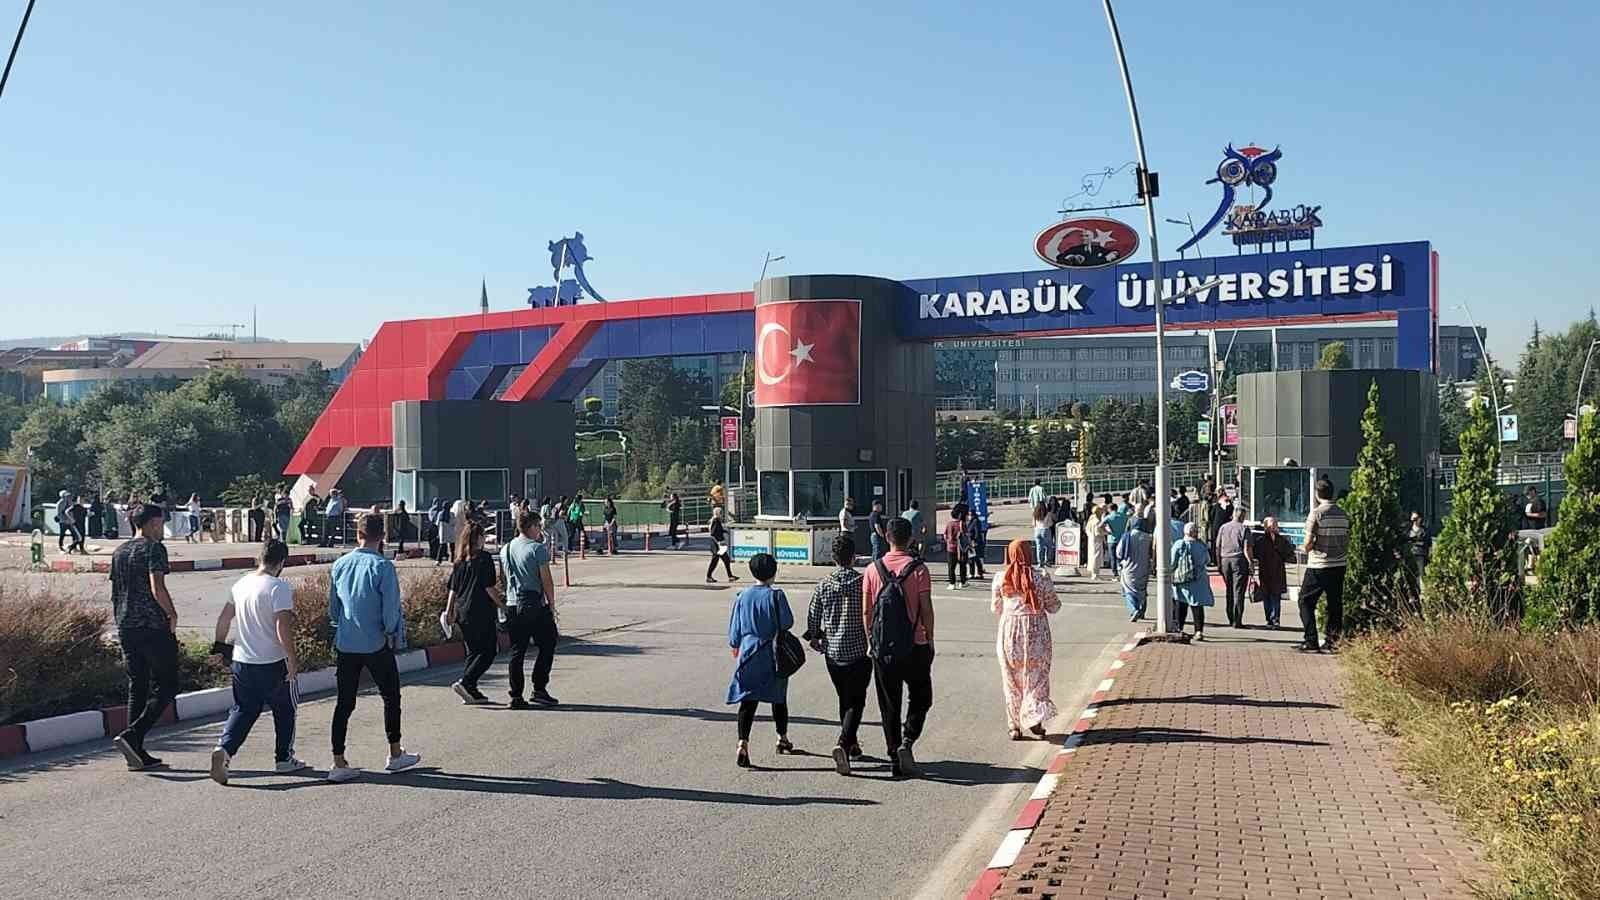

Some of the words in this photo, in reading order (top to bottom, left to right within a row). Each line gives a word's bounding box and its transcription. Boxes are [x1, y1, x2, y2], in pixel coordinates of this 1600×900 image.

[1223, 204, 1323, 229] KARABÜK
[919, 278, 1083, 319] KARABÜK
[1117, 254, 1392, 308] ÜNİVERSİTESİ
